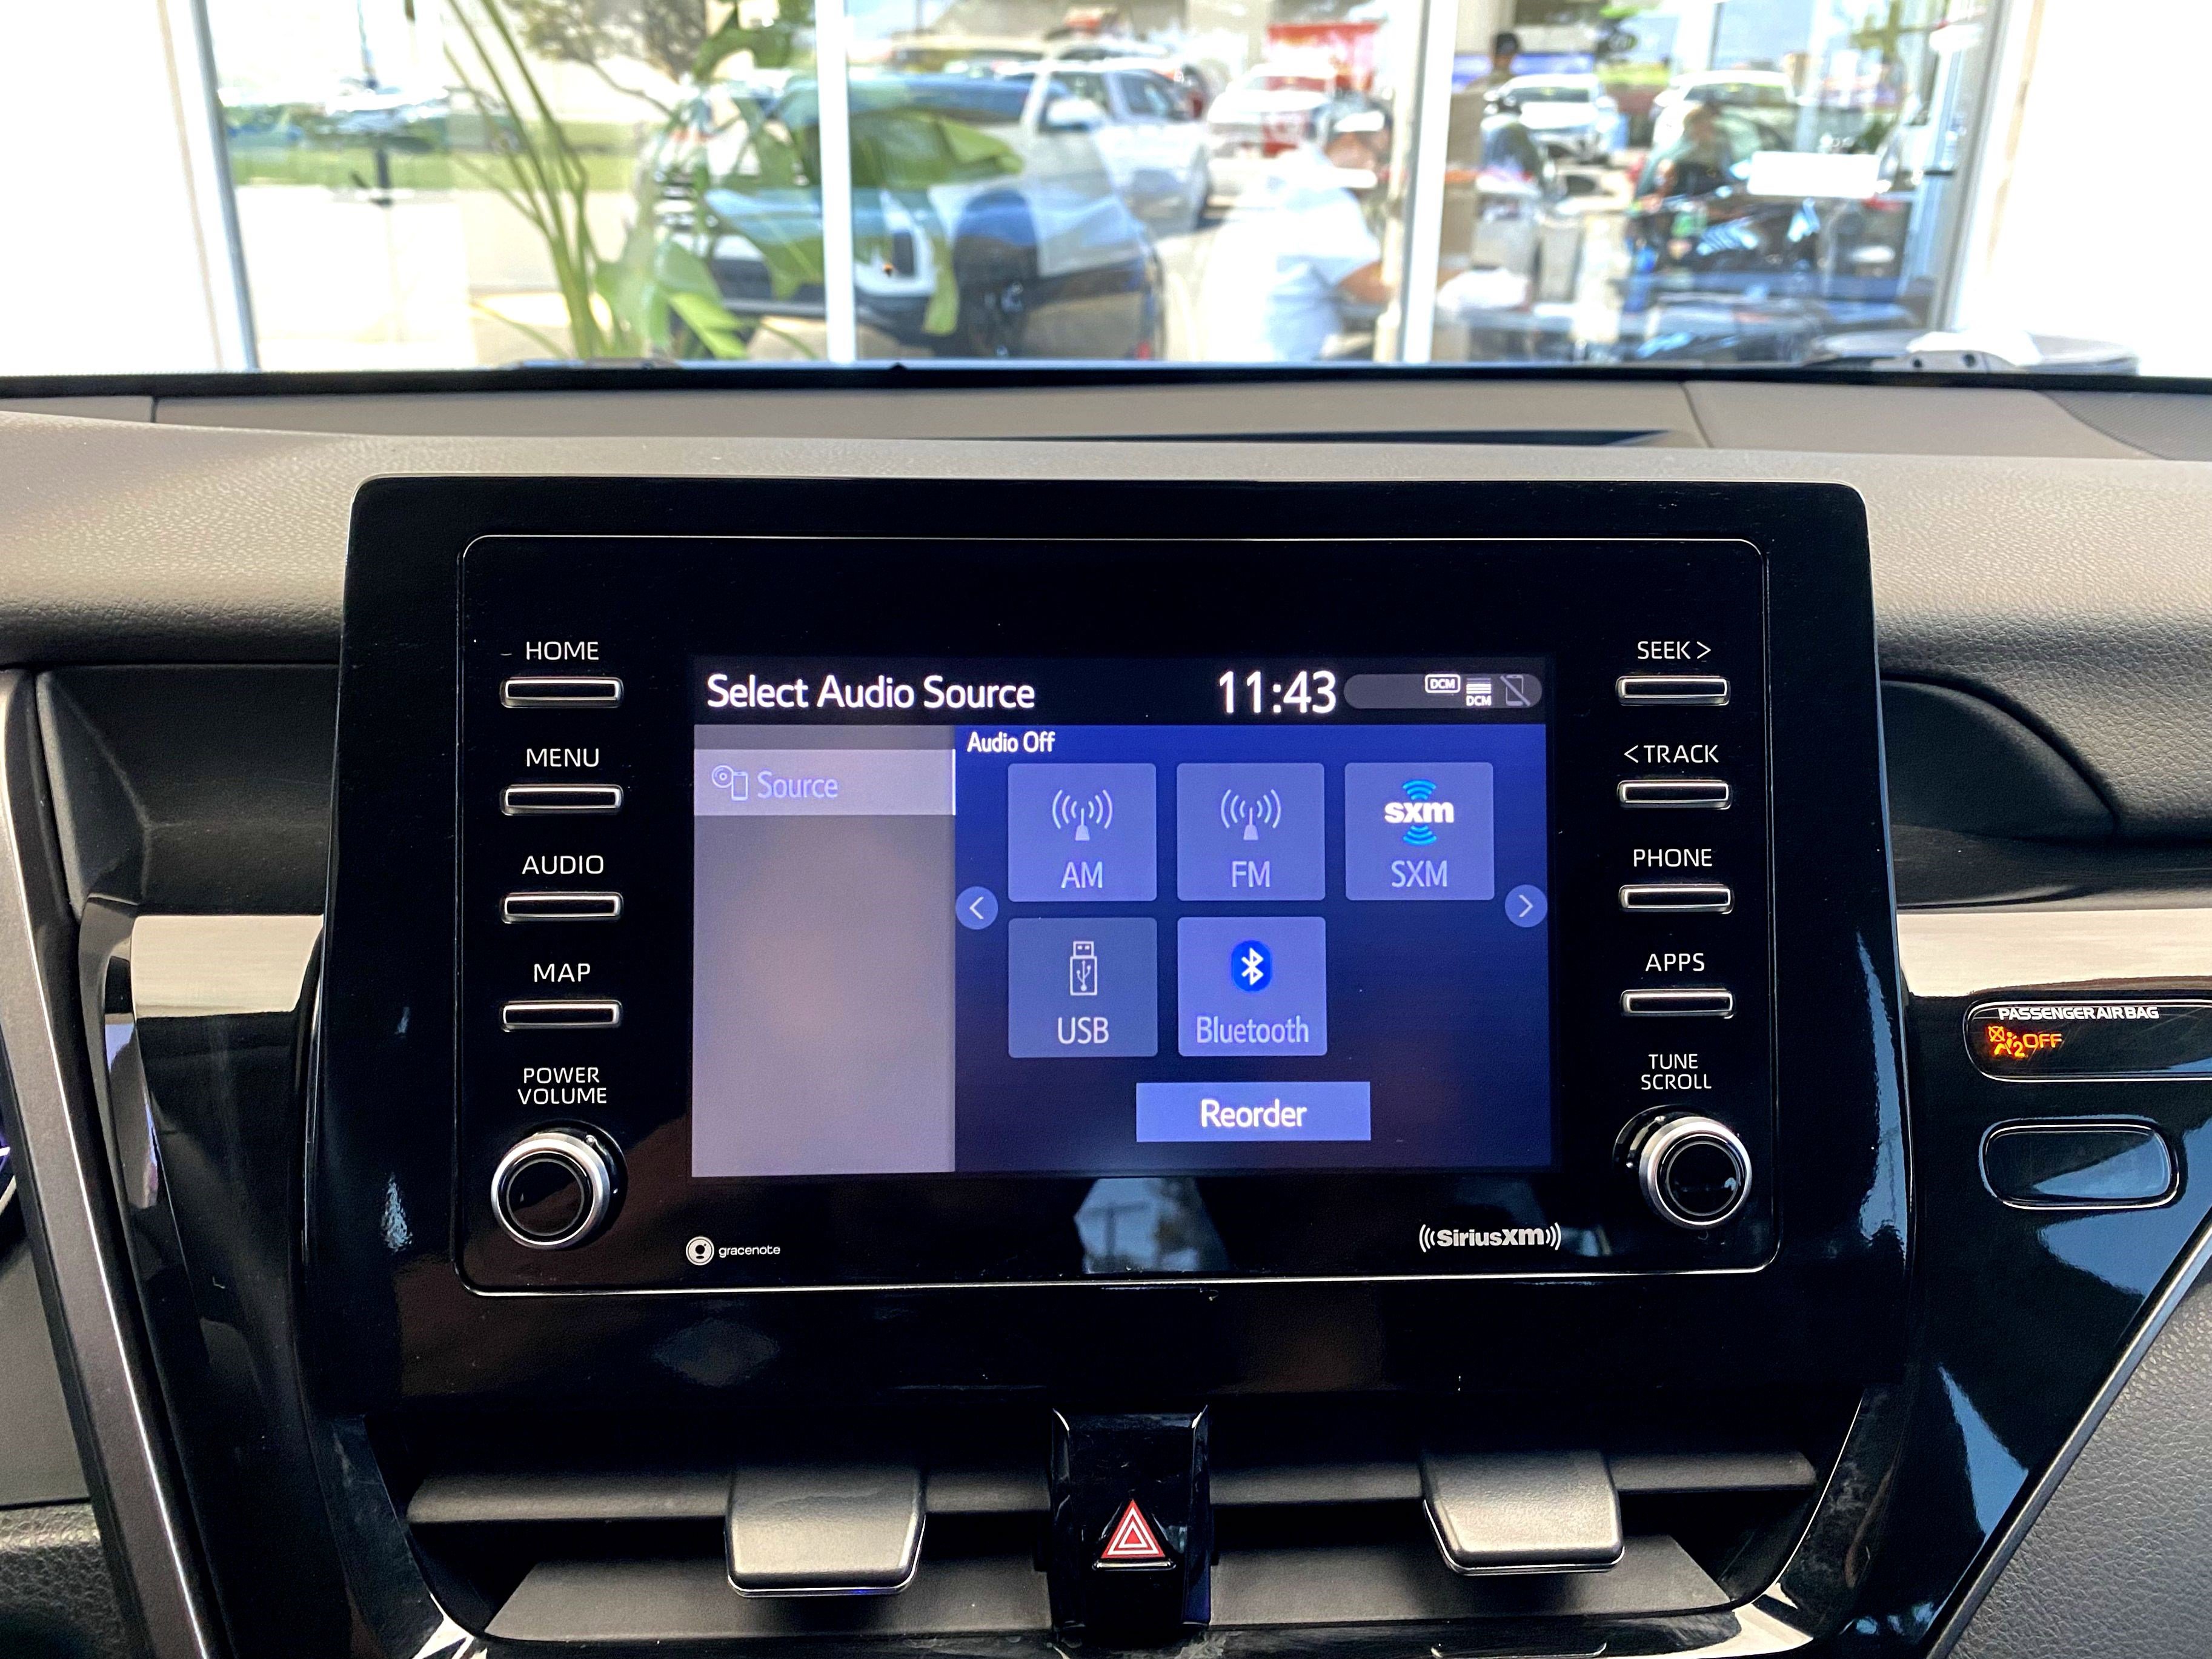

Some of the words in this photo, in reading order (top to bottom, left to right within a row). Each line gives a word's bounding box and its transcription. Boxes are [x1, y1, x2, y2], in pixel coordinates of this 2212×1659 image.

[526, 640, 599, 660] HOME
[1637, 640, 1691, 659] SEEK
[706, 673, 809, 709] Select
[816, 674, 915, 709] Audio
[923, 675, 1035, 709] Source
[1218, 670, 1337, 714] 11:43
[1430, 679, 1455, 690] DCM
[1466, 695, 1492, 706] DCM
[967, 731, 1018, 753] Audio
[1023, 731, 1055, 753] Off
[526, 748, 600, 767] MENU
[1644, 745, 1719, 763] TRACK
[757, 771, 839, 799] Source
[1384, 802, 1455, 824] sxm
[522, 855, 604, 874] AUDIO
[1633, 848, 1713, 867] PHONE
[1060, 861, 1104, 889] AM
[1231, 860, 1271, 888] FM
[1390, 860, 1448, 888] SXM
[1646, 953, 1705, 972] APPS
[534, 963, 591, 983] MAP
[1998, 1008, 2096, 1020] PASSENGER
[1057, 1017, 1109, 1044] USB
[1196, 1016, 1309, 1043] Bluetooth
[1649, 1054, 1699, 1069] TUNE
[523, 1067, 600, 1083] POWER
[1641, 1074, 1712, 1090] SCROLL
[517, 1088, 607, 1105] VOLUME
[1200, 1099, 1307, 1128] Reorder
[719, 1245, 780, 1258] gracenote
